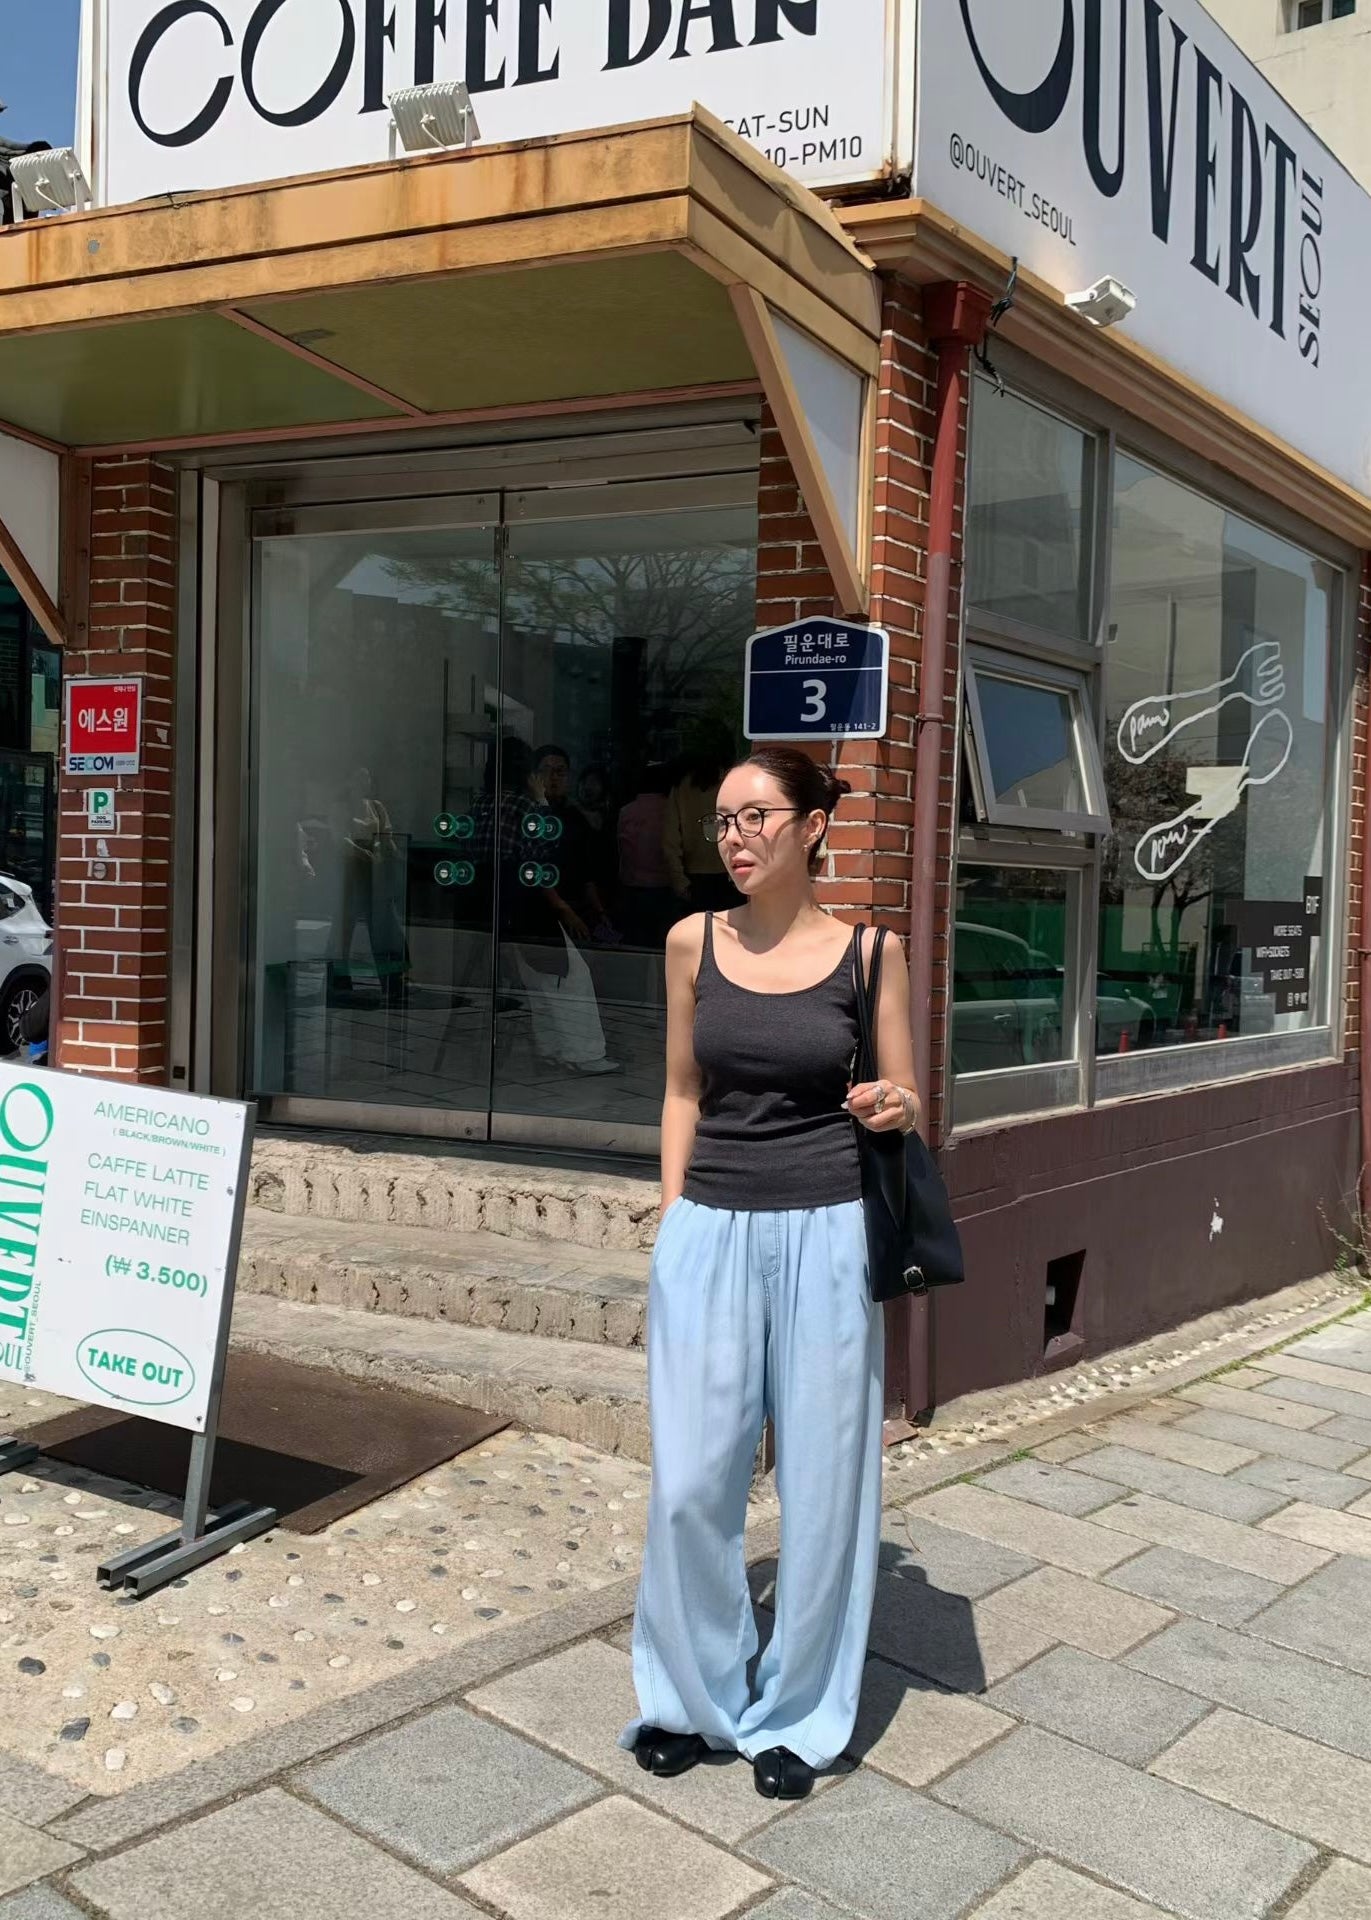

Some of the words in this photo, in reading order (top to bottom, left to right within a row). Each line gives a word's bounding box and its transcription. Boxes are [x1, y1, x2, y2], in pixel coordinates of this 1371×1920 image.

[724, 105, 829, 138] AT-SUN
[950, 133, 1077, 246] @OUVERT_SEOUL
[1298, 169, 1323, 369] SEOUL
[783, 632, 850, 653] 필운대로
[785, 653, 847, 665] Pirundae-ro
[800, 679, 827, 722] 3
[78, 707, 128, 733] 에스원
[854, 722, 876, 730] 141-2
[70, 756, 114, 771] SECOM
[93, 792, 108, 813] P
[94, 1101, 210, 1136] AMERICANO
[88, 1153, 148, 1178] CAFFE
[152, 1165, 210, 1191] LATTE
[84, 1181, 129, 1203] FLAT
[133, 1191, 194, 1217] WHITE
[80, 1208, 190, 1246] EINSPANNER
[87, 1347, 137, 1377] TAKE
[142, 1362, 184, 1388] OUT
